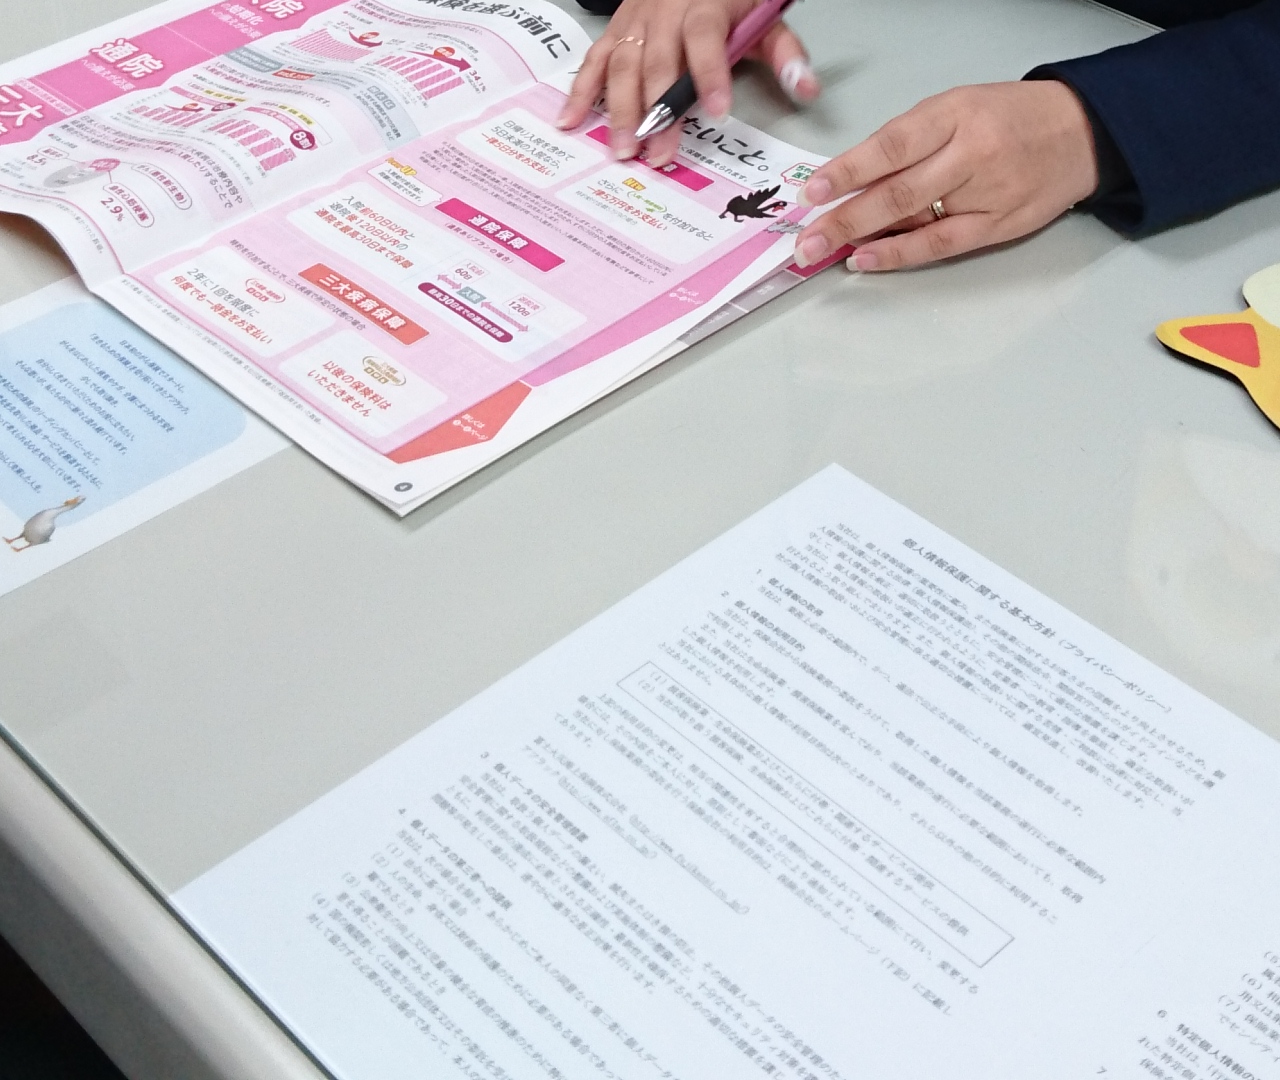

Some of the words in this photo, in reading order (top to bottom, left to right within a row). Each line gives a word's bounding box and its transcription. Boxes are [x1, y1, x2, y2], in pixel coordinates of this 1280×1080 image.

[90, 38, 165, 80] 通院
[476, 132, 558, 177] 一律5日分をお支払い
[489, 125, 565, 168] 5日未満の入院なら、
[501, 119, 576, 162] 日帰り入院を含めて
[583, 184, 671, 231] 一律5万円をお支払い
[622, 176, 647, 192] NEW
[326, 201, 410, 251] 退院後120日以内の
[340, 194, 417, 240] 入院前60日以内と
[466, 213, 530, 250] 通院保障
[595, 178, 624, 194] さらに
[660, 212, 715, 241] を付加すると
[312, 207, 415, 269] 通院を最高30日まで保障
[185, 267, 260, 317] 2年に1回を限度に
[452, 267, 474, 281] 60日
[169, 274, 273, 345] 何度でも一時金をお支払い
[316, 273, 409, 331] 三大疾病保障
[505, 300, 533, 317] 120日
[305, 368, 374, 418] いただきません
[321, 360, 392, 411] 以後の保険料は
[899, 537, 1175, 715] 個人情報保護に関する基本方針（プライバシーポリシー）
